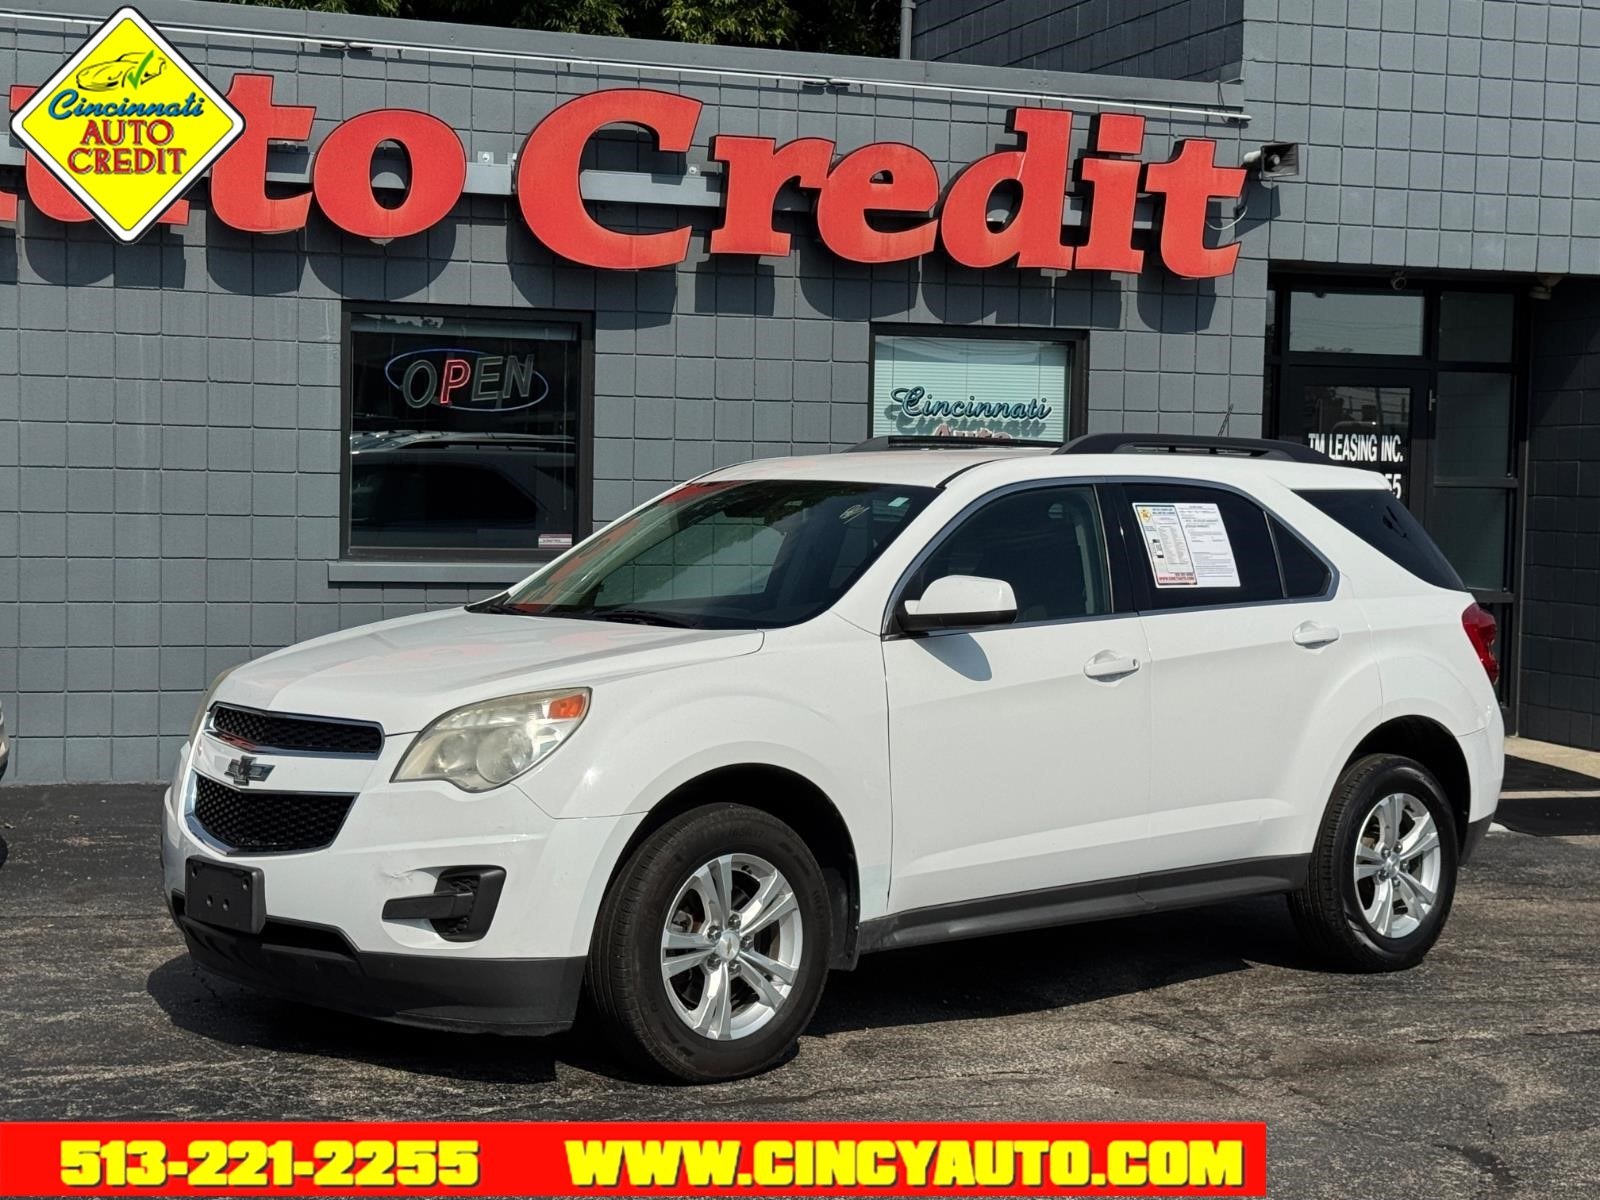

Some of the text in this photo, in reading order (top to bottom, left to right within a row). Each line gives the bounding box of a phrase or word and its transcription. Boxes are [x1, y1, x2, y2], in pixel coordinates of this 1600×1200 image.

[0, 73, 1247, 279] to Credit
[402, 353, 536, 410] OPEN
[889, 385, 1053, 420] Cincinnati
[1308, 433, 1404, 463] TM LEASING INC.
